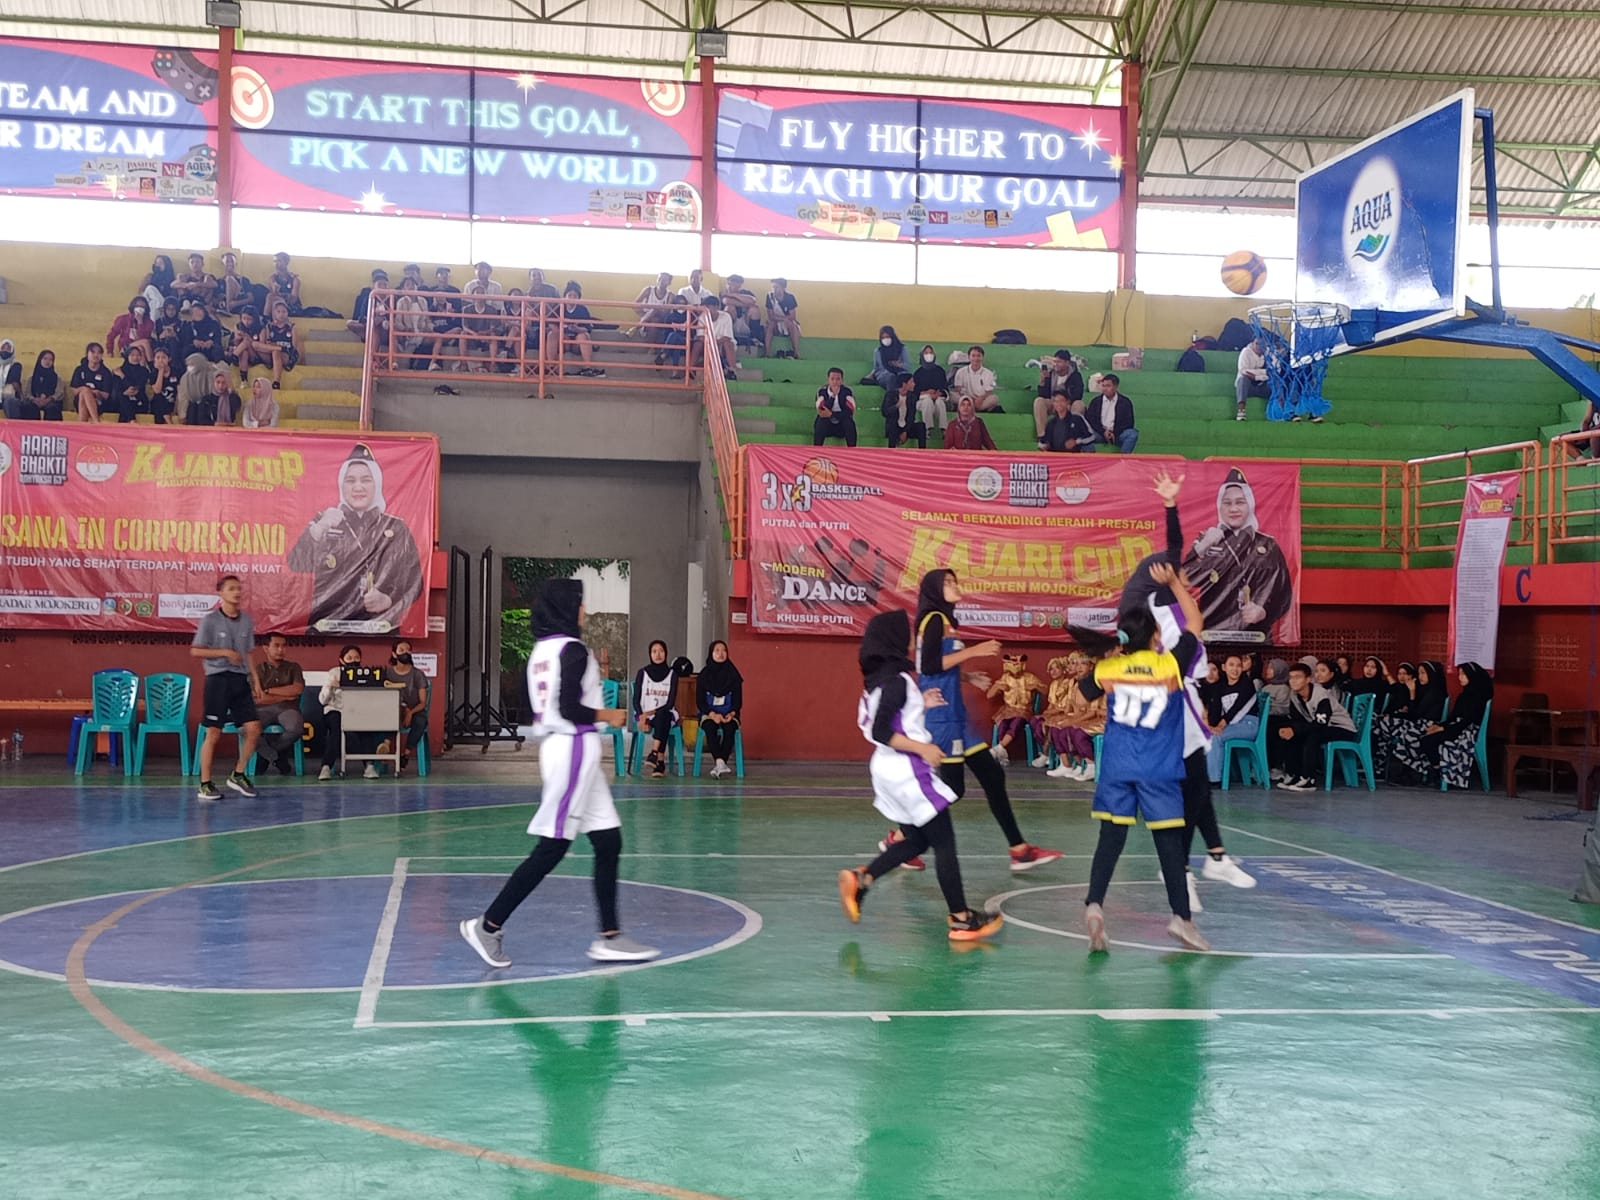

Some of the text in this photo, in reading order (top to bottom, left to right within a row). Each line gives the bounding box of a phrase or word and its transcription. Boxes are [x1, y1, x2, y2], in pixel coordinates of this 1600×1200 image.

[100, 89, 176, 117] AND
[306, 88, 641, 149] START THIS GOAL,
[34, 122, 166, 158] DREAM
[779, 117, 1065, 162] FLY HIGHER TO
[186, 161, 212, 172] AQUA
[289, 136, 658, 186] PICK A NEW WORLD
[181, 184, 214, 196] Grab
[743, 162, 1099, 216] REACH YOUR GOAL
[797, 207, 829, 220] Grab
[906, 208, 926, 217] AQUA
[1350, 190, 1392, 235] AQUA
[21, 434, 56, 455] HARI
[20, 455, 66, 474] BHAKTI
[126, 442, 304, 490] KAJARI CUP
[1010, 463, 1039, 480] HARI
[156, 479, 214, 488] KABUPATEN
[811, 483, 884, 496] BASKETBALL
[1009, 480, 1047, 498] BHAKTI
[811, 492, 864, 501] TOURNAMENT
[761, 518, 850, 531] PUTRA dan PUTRI
[901, 510, 1156, 531] SELAMAT BERTANDING MERAIH PRESTASI
[1, 513, 286, 556] SANA IN CORPORESANO
[6, 556, 46, 567] TUBUH
[49, 557, 81, 568] YANG
[83, 558, 122, 569] SEHAT
[125, 559, 185, 572] TERDAPAT
[187, 561, 215, 572] JIWA
[217, 562, 249, 573] YANG
[251, 563, 282, 574] KUAT
[896, 524, 1065, 591] KAJARI
[771, 562, 825, 578] MODERN
[781, 575, 868, 602] DANCE
[956, 580, 1114, 599] ABUPATEN MOJOKERTO
[1515, 567, 1532, 604] C
[34, 599, 100, 610] MOJOKERTO
[776, 613, 854, 625] KHUSUS PUTRI
[346, 669, 354, 680] 1
[373, 669, 380, 680] 1
